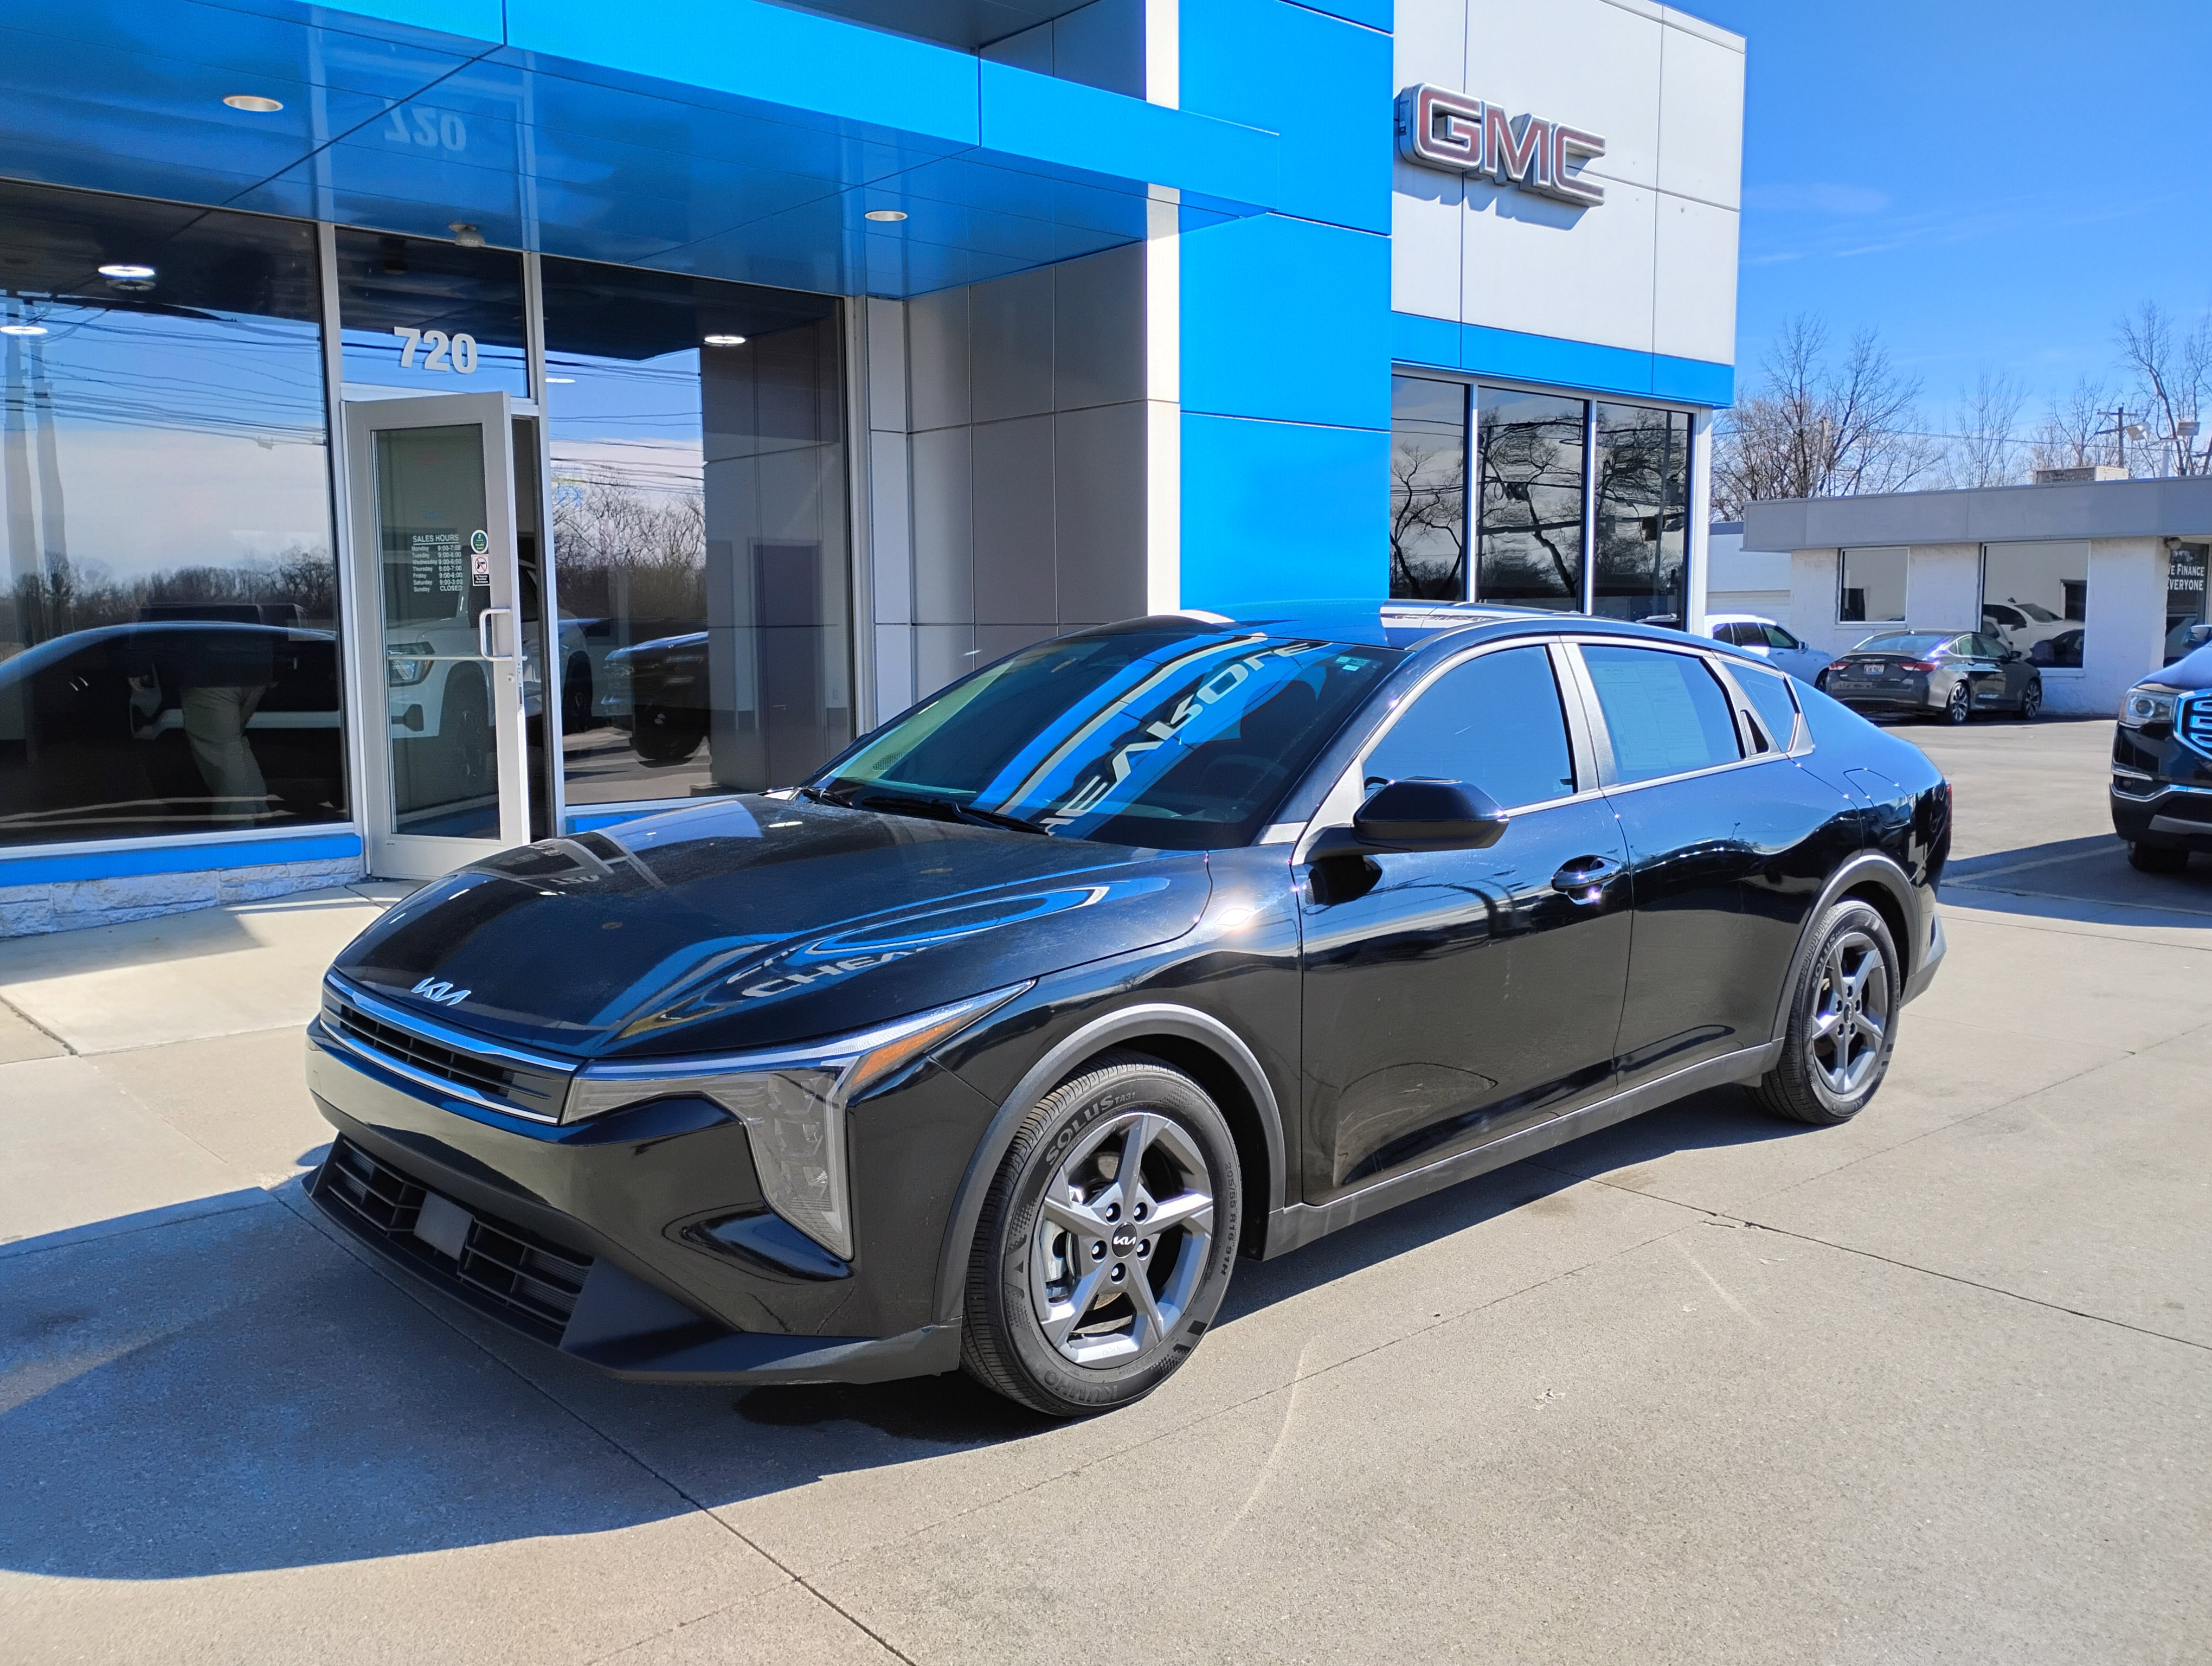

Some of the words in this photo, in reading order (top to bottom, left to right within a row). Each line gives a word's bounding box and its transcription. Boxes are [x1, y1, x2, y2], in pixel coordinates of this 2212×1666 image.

[1410, 82, 1606, 207] GMC
[394, 326, 478, 375] 720
[2167, 577, 2204, 591] VERYONE
[2177, 563, 2204, 576] FINANCE
[410, 976, 472, 1006] KIA
[1046, 1094, 1114, 1166] SOLUS
[1225, 1162, 1236, 1208] 205/55
[1113, 1236, 1136, 1245] KIA
[1227, 1213, 1236, 1242] R16
[1220, 1245, 1232, 1276] 91H
[1044, 1369, 1118, 1404] KUMHO
